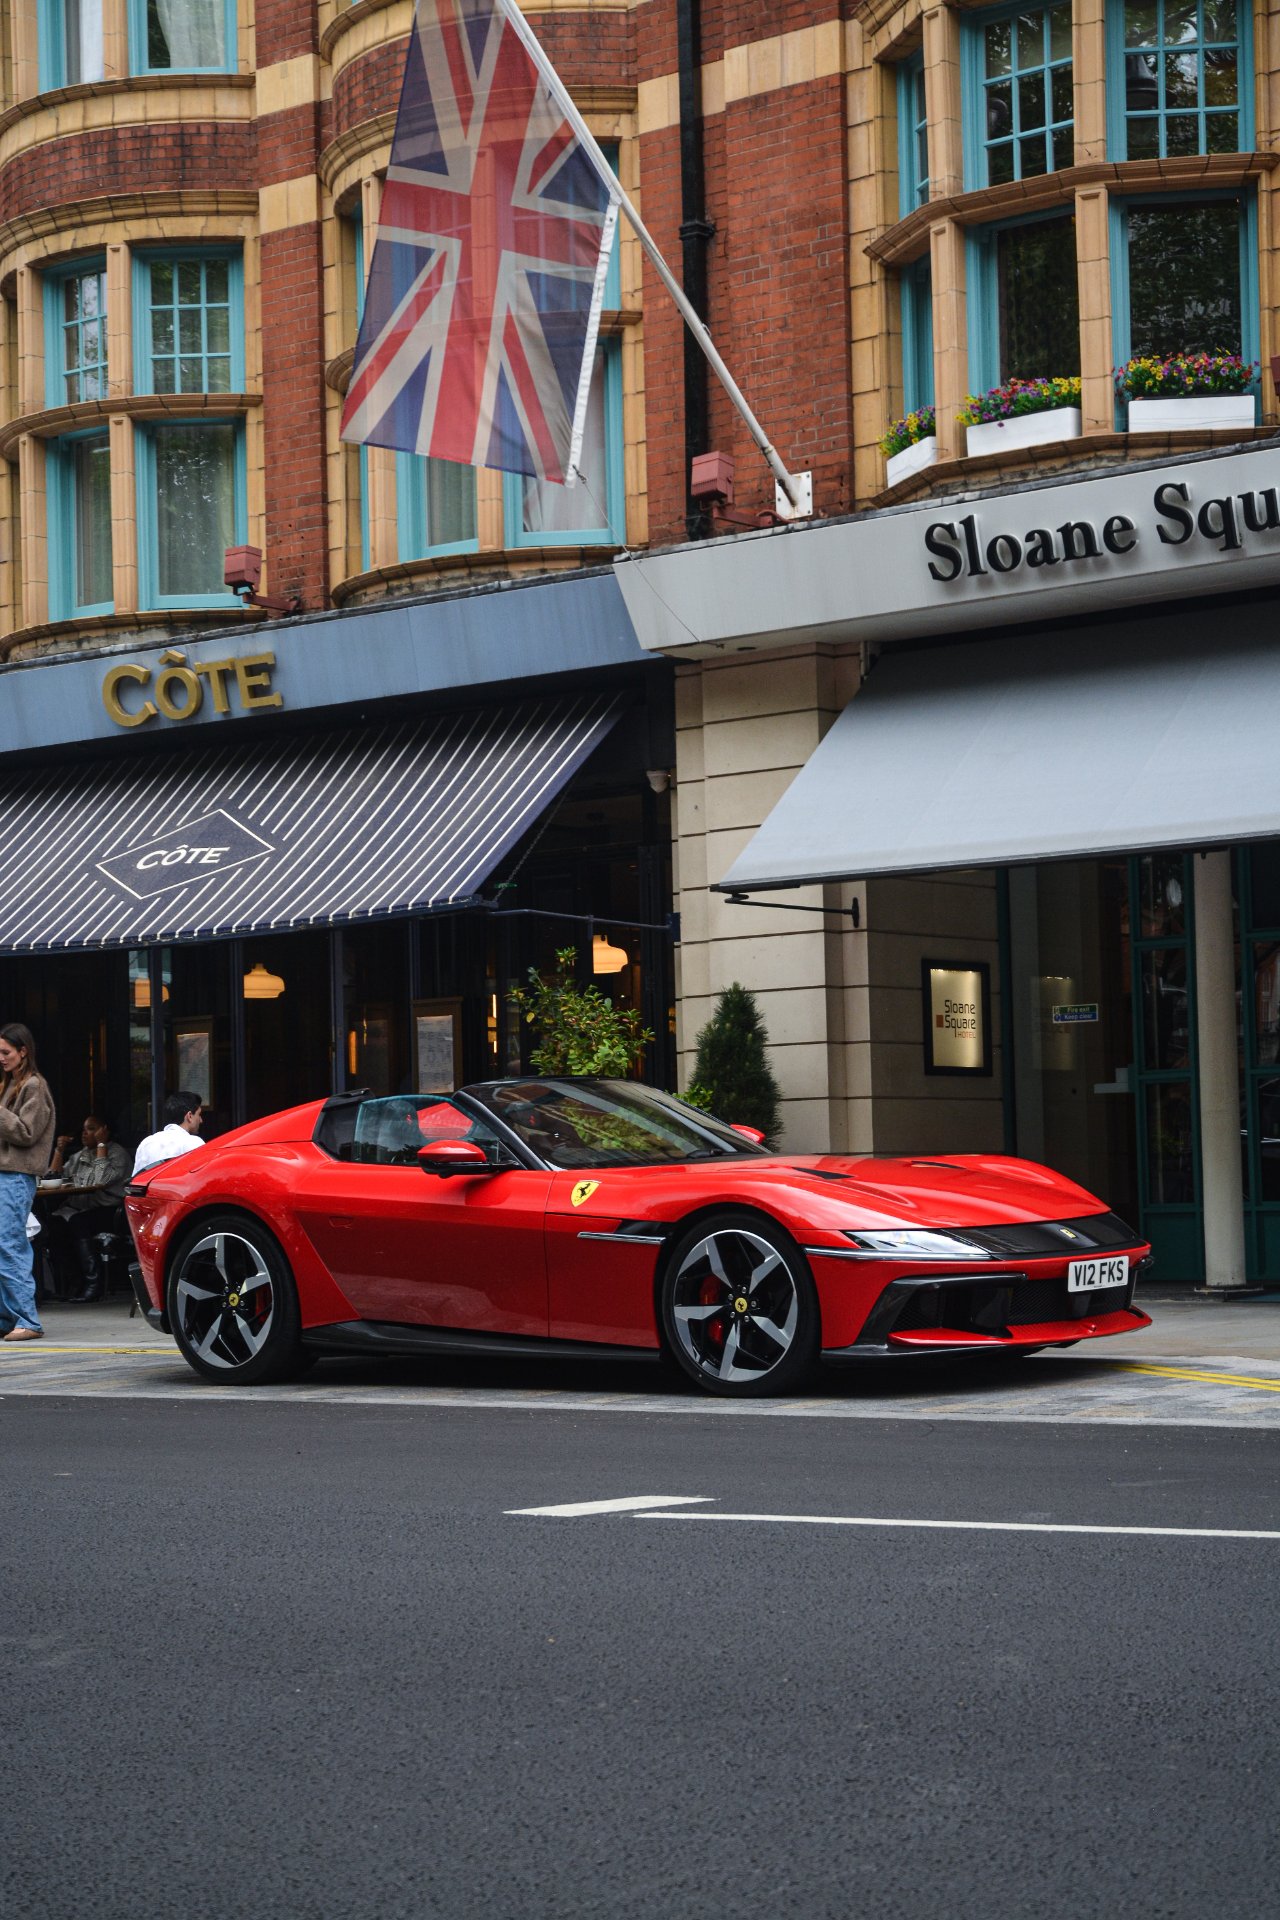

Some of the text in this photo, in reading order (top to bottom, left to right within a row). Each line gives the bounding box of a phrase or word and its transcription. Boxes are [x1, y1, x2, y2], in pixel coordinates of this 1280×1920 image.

[924, 482, 1280, 582] Sloane Squ
[102, 650, 283, 727] CÔTE
[136, 844, 231, 870] CÔTE
[944, 999, 976, 1015] Sloane
[944, 1014, 976, 1038] Square
[1074, 1260, 1124, 1286] V12 FKS
